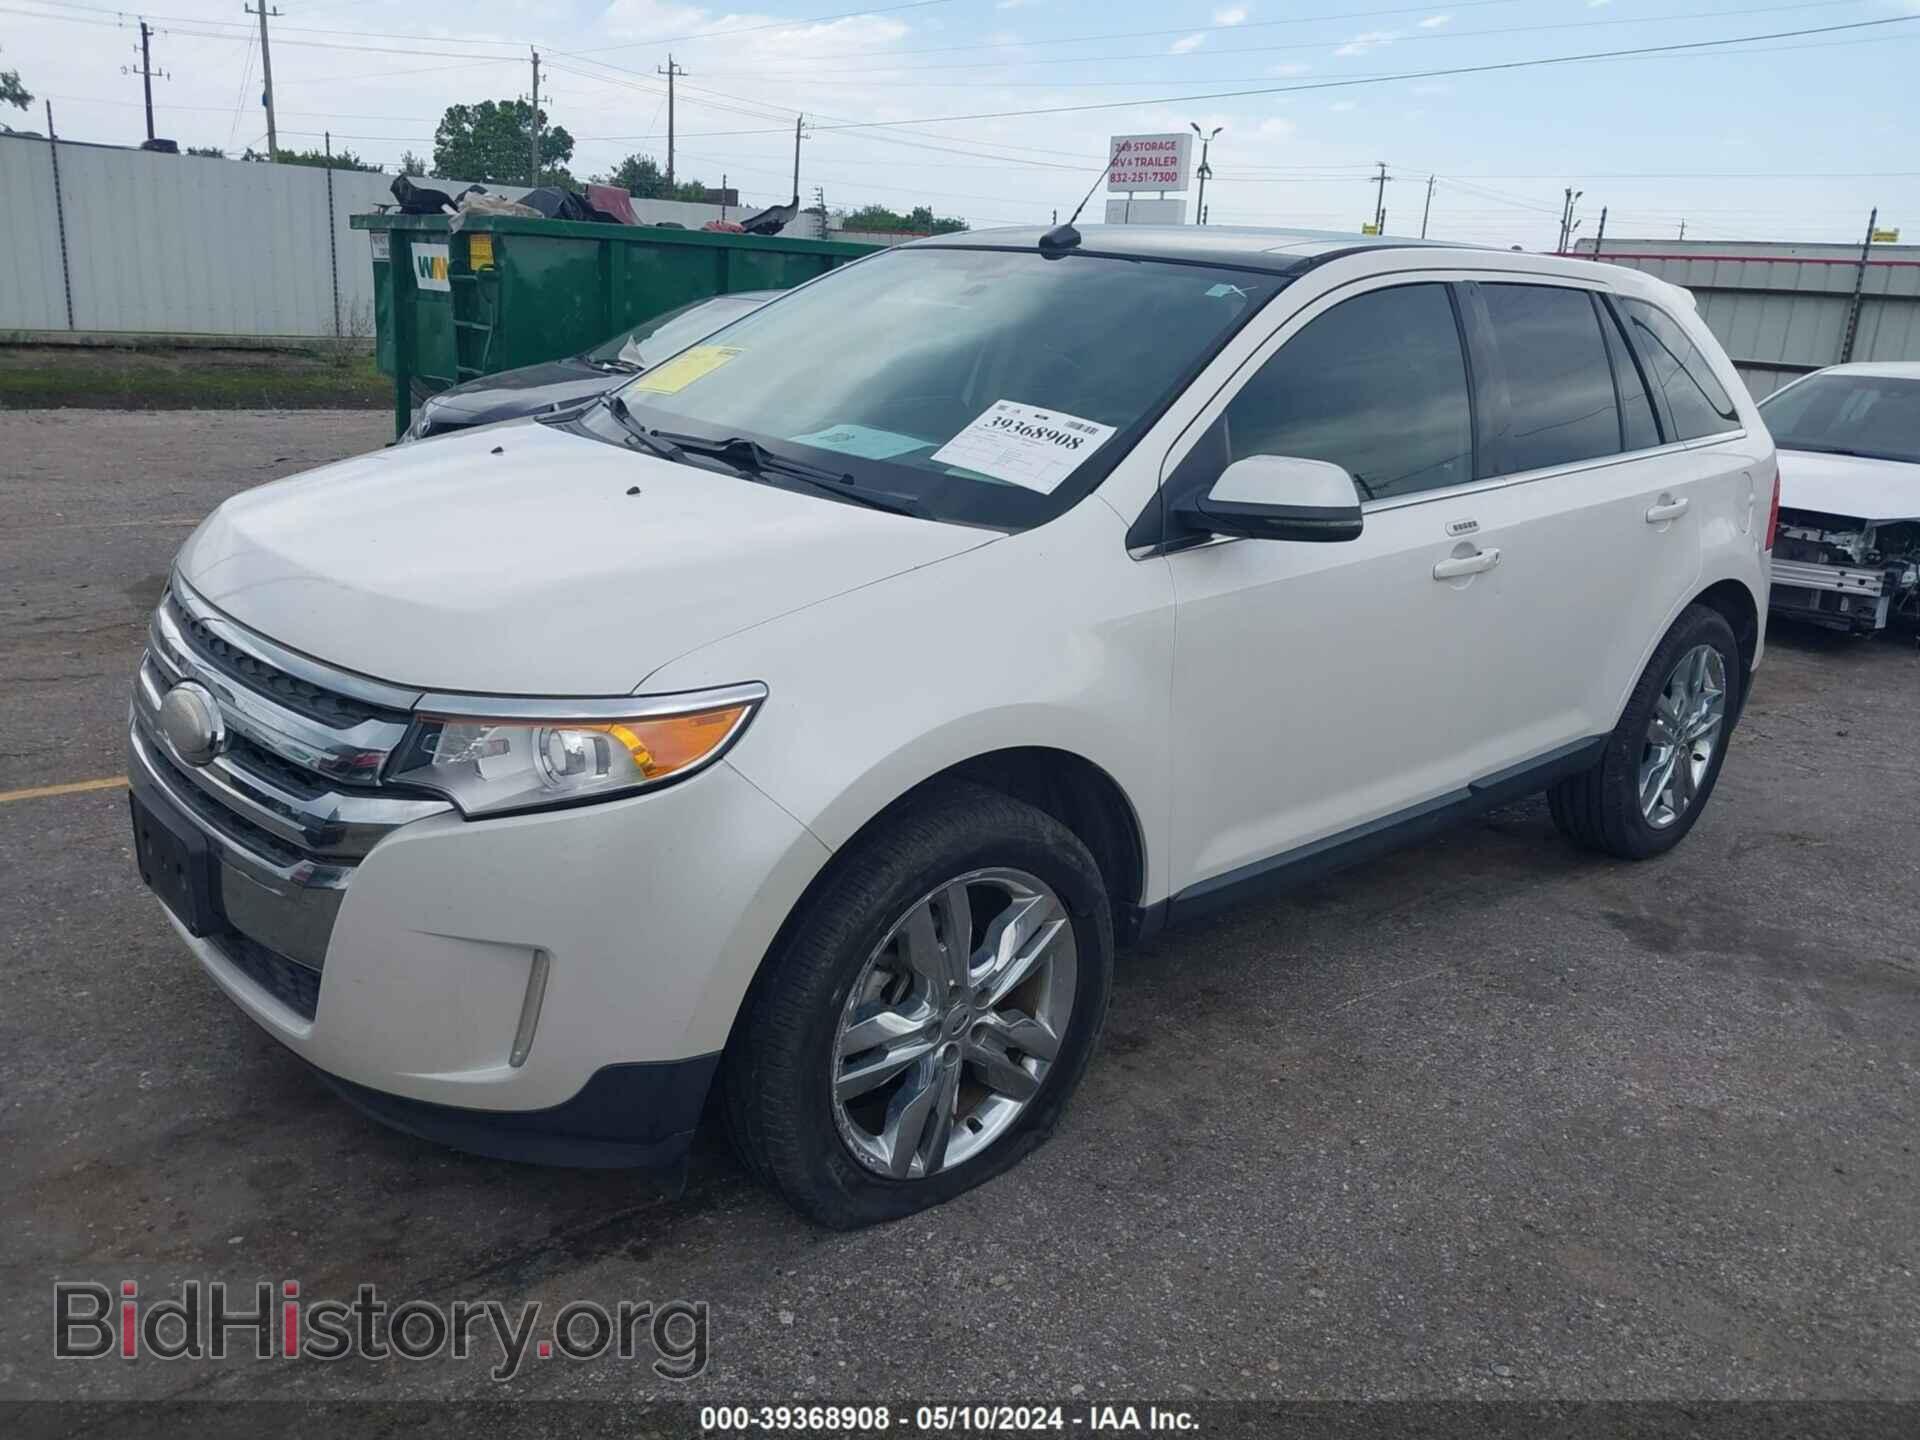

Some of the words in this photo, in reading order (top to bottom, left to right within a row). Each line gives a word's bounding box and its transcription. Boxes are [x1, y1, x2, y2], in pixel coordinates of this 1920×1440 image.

[1134, 141, 1176, 152] STORAGE
[1135, 157, 1177, 167] TRAILER
[1110, 172, 1177, 183] 832-251-7300
[984, 415, 1084, 451] 39368908
